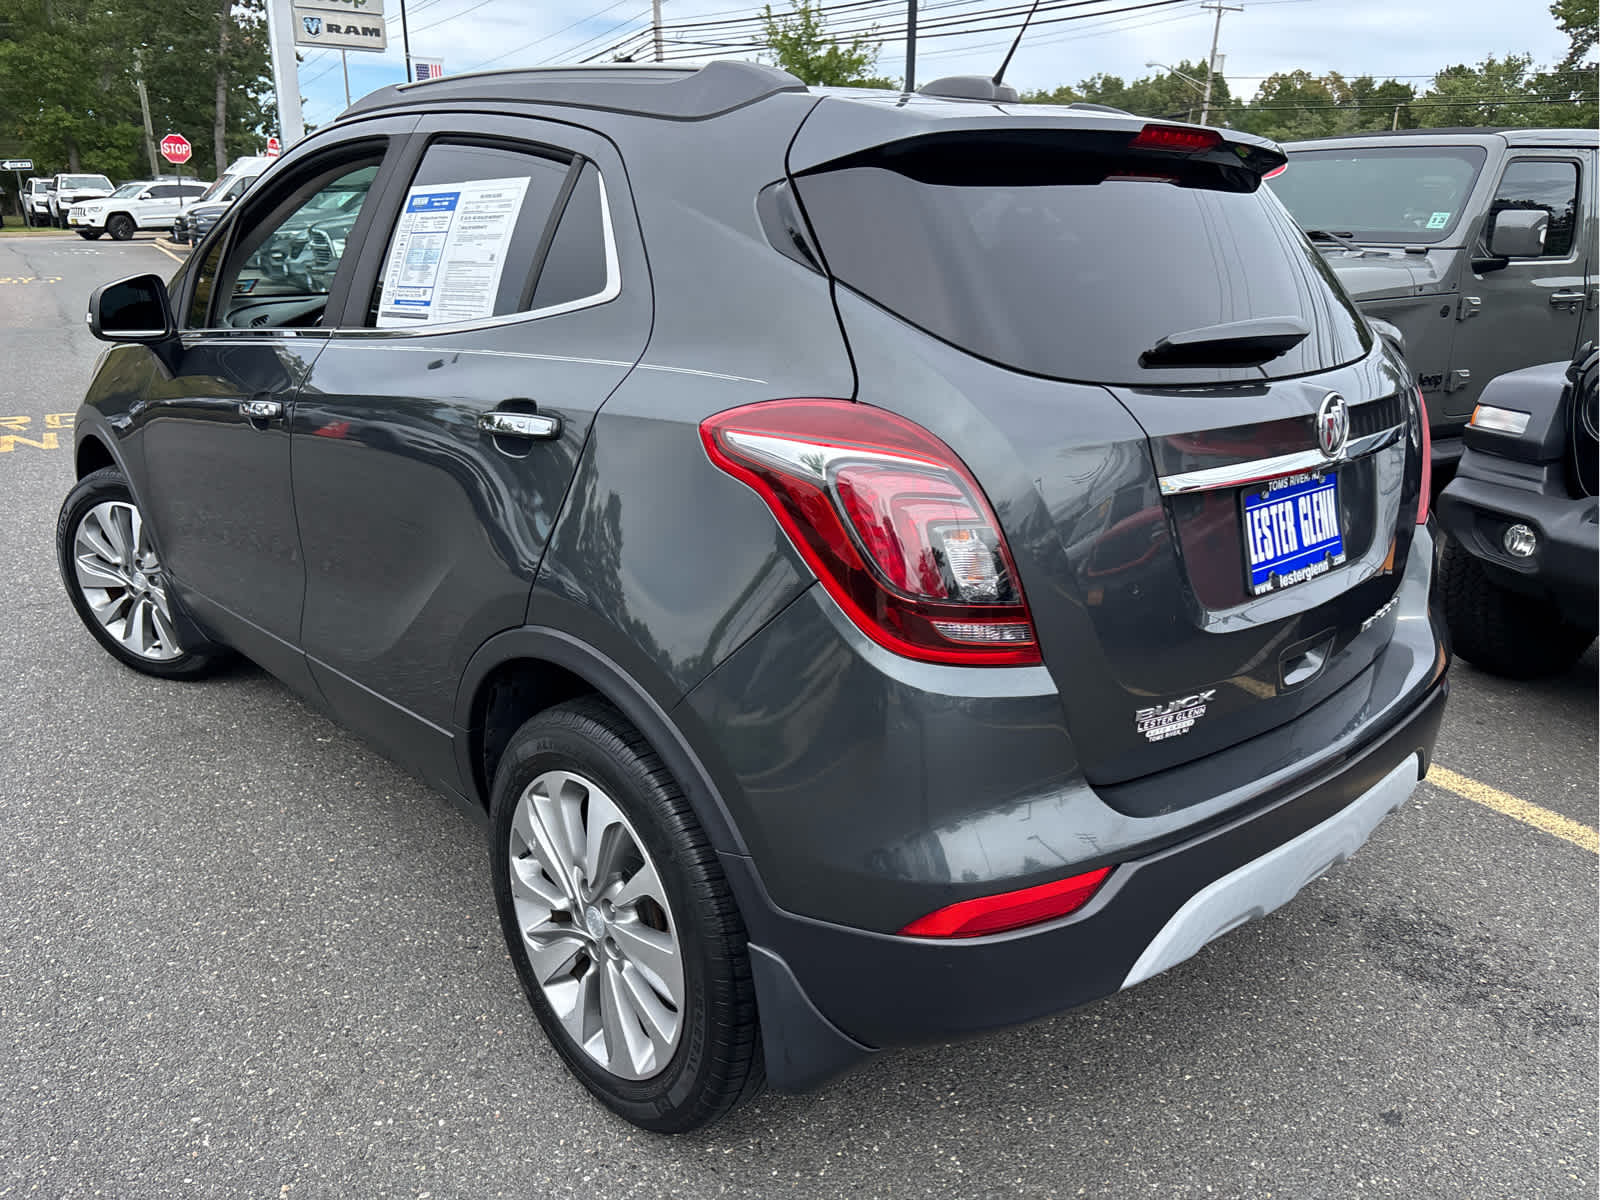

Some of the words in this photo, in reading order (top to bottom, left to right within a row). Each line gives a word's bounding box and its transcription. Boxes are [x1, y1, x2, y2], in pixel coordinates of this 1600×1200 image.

[326, 23, 381, 37] RAM
[163, 143, 189, 155] STOP
[1419, 373, 1442, 388] Jeep
[1268, 478, 1288, 492] TOMS
[1246, 500, 1298, 565] LESTER
[1298, 488, 1339, 547] GLENN
[1280, 561, 1329, 588] lesterglenn
[1135, 689, 1216, 721] BUICK
[1137, 715, 1174, 731] LESTER
[1176, 706, 1206, 720] GLENN
